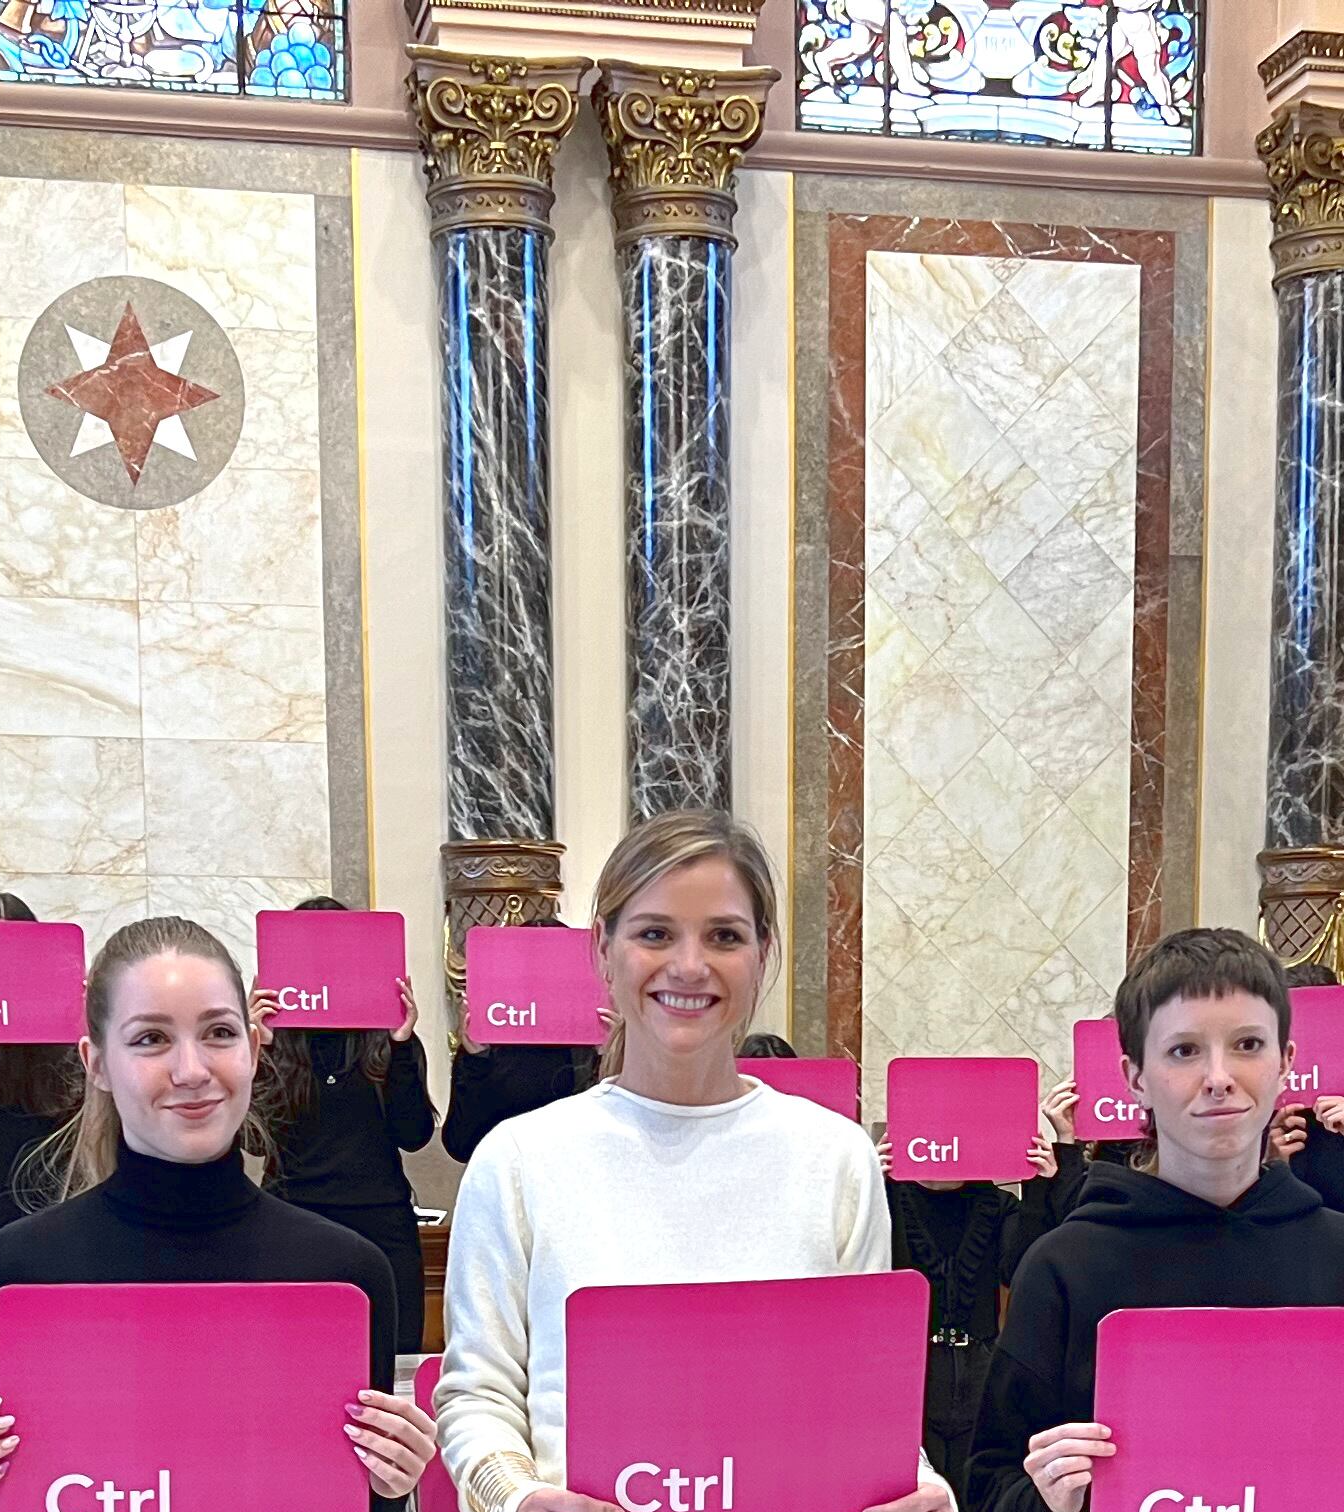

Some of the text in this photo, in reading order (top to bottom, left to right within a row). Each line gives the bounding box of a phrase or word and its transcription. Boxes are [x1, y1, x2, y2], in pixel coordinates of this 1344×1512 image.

[279, 985, 329, 1011] Ctrl
[486, 1001, 536, 1026] Ctrl
[1285, 1064, 1319, 1092] trl
[907, 1136, 959, 1163] Ctrl
